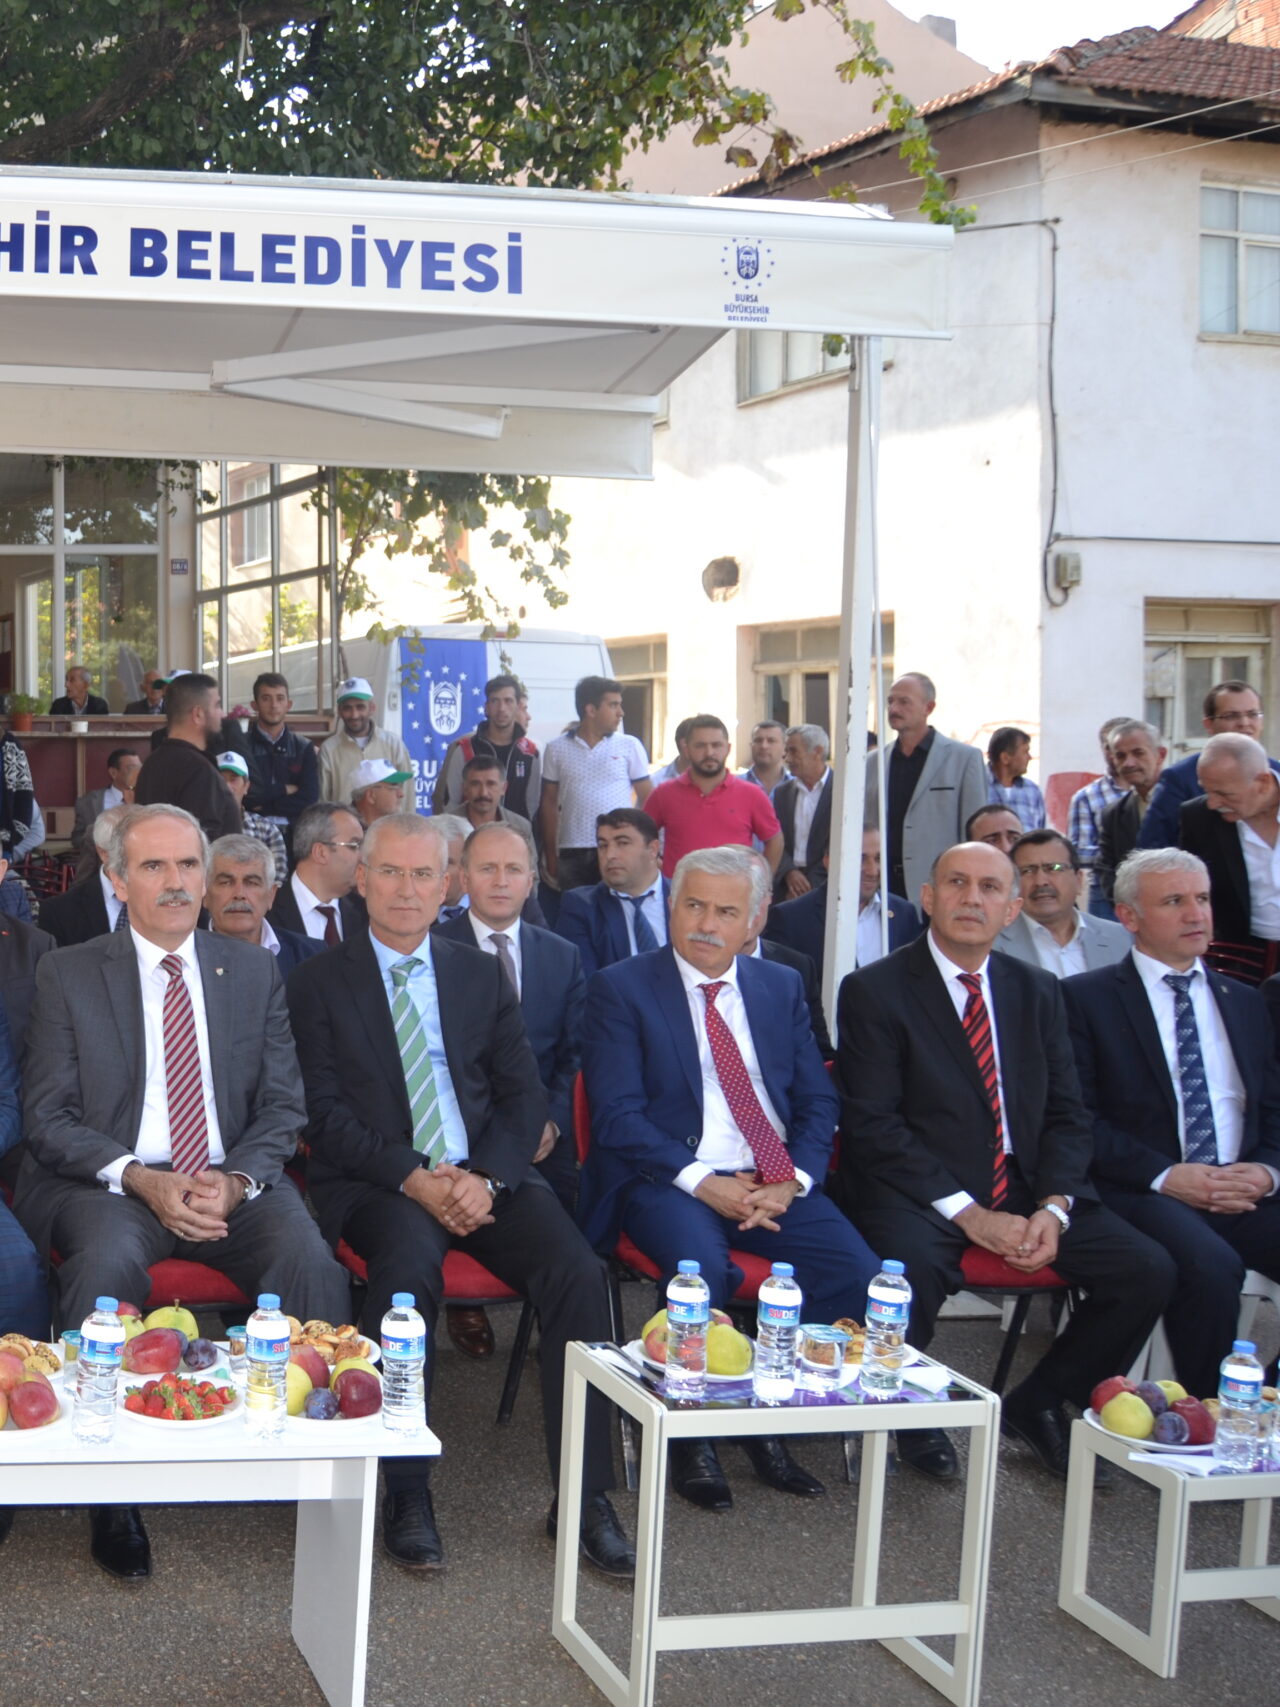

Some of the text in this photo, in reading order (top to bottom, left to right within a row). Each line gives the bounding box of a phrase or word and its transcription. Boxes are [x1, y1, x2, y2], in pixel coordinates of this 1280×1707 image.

[130, 225, 522, 294] BELEDİYESİ
[735, 293, 759, 302] BURSA
[410, 759, 443, 778] BU
[415, 795, 432, 809] EL
